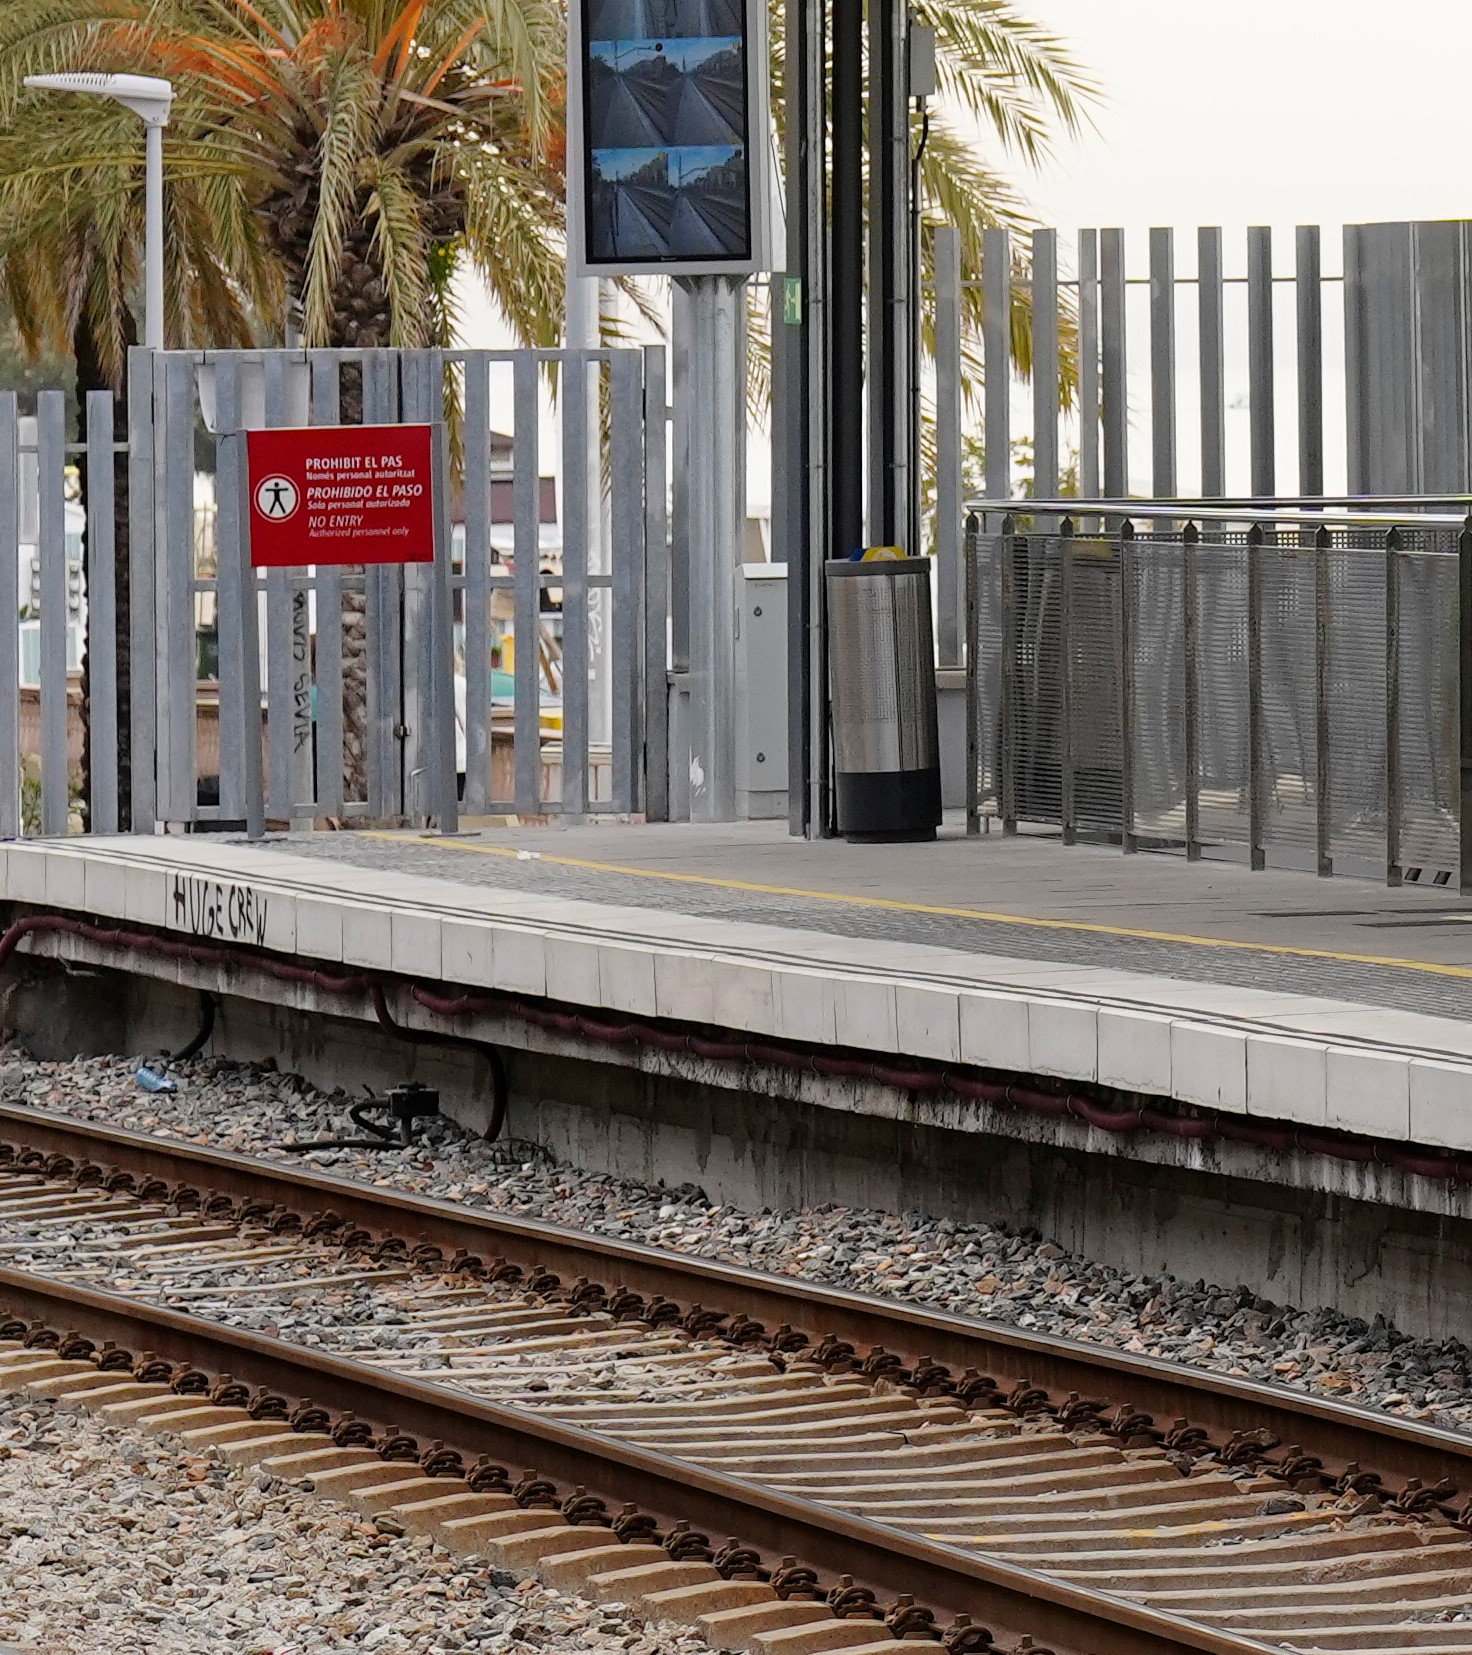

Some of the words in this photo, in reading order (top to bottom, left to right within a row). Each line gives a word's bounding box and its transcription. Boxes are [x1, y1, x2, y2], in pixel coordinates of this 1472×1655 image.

[306, 457, 361, 470] PROHIBIT
[365, 456, 378, 468] EL
[381, 455, 403, 467] PAS
[337, 470, 372, 482] personal
[307, 485, 372, 499] PROHIBIDO
[376, 485, 389, 497] EL
[392, 484, 423, 496] PASO
[328, 499, 364, 511] personal
[366, 498, 411, 507] autorizado
[308, 516, 326, 528] NO
[329, 515, 363, 527] ENTRY
[173, 873, 223, 936] HUGE
[228, 883, 267, 946] CREW
